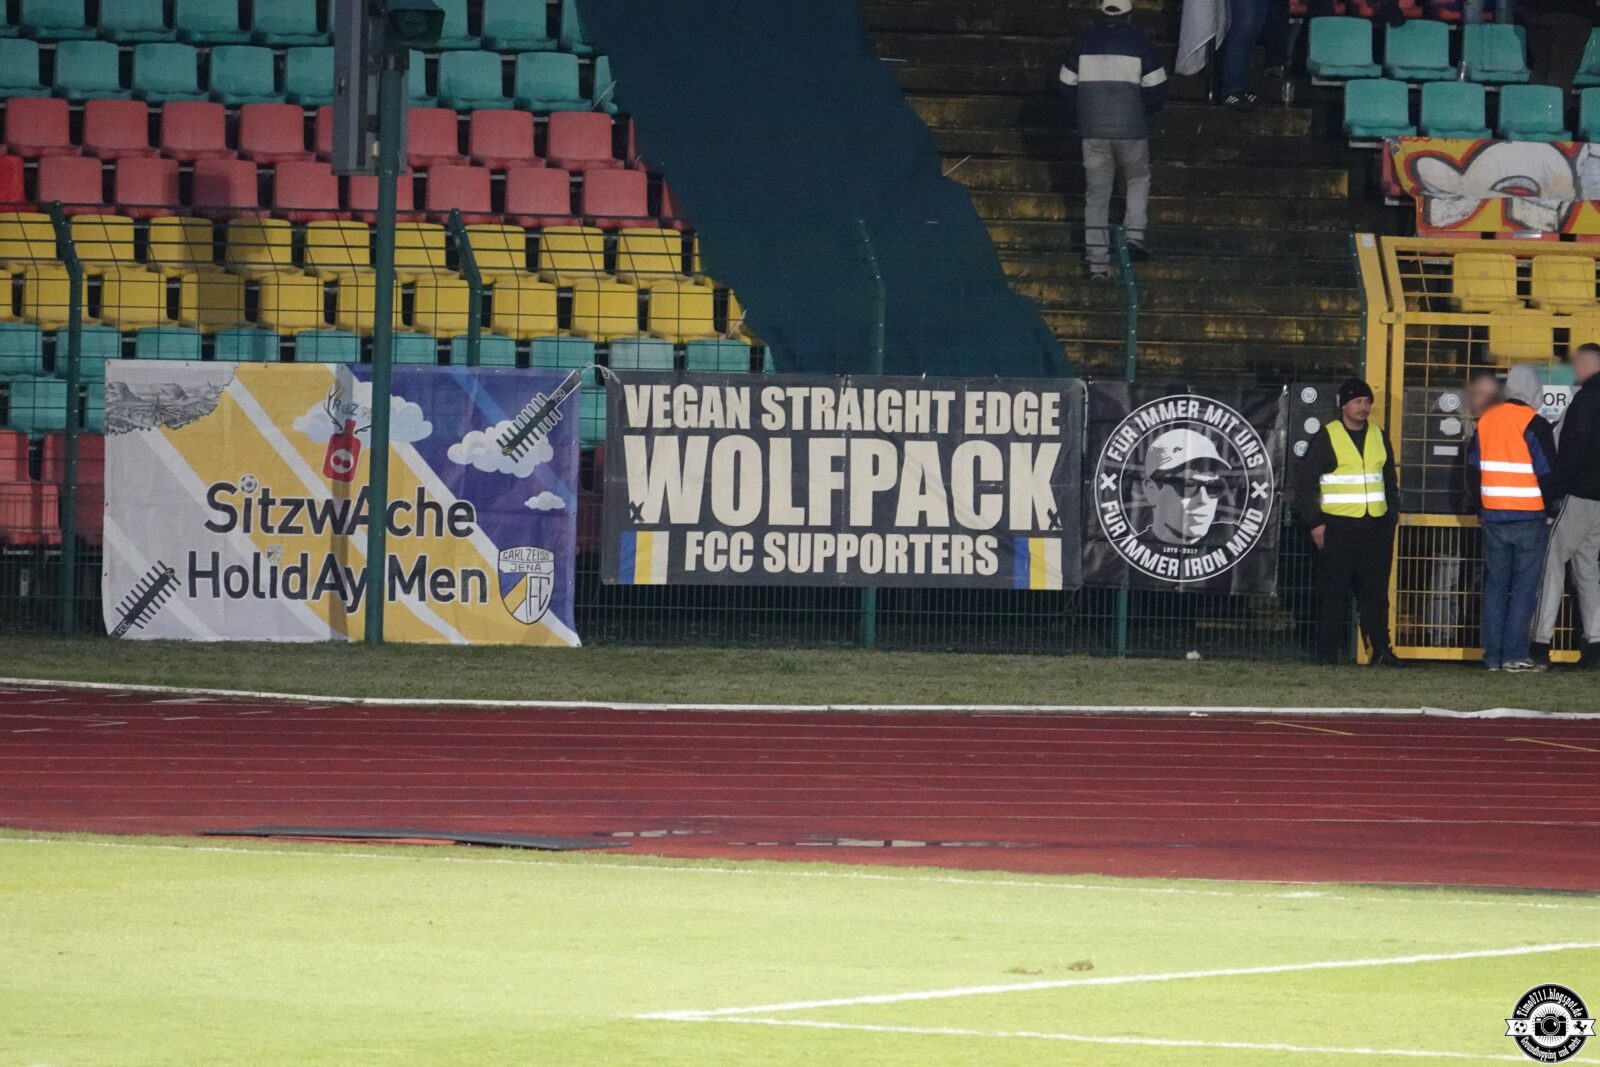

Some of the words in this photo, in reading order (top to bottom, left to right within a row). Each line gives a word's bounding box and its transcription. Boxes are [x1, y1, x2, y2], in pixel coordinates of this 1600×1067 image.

[624, 384, 751, 430] VEGAN
[761, 387, 956, 435] STRAIGHT
[965, 391, 1060, 436] EDGE
[1107, 424, 1139, 463] FÜR
[1135, 400, 1200, 432] IMMER
[1204, 404, 1240, 434] MIT
[1234, 430, 1265, 469] UNS
[204, 476, 477, 538] SitzwAche
[624, 435, 1063, 531] WOLFPACK
[510, 562, 542, 572] JENA
[685, 530, 754, 573] FCC
[763, 532, 999, 576] SUPPORTERS
[1100, 500, 1128, 538] FÜR
[1119, 533, 1181, 577] IMMER
[1184, 548, 1229, 577] IRON
[1227, 507, 1264, 556] MIND
[188, 547, 366, 613] HolidAy
[389, 553, 488, 604] Men
[529, 576, 551, 617] FC
